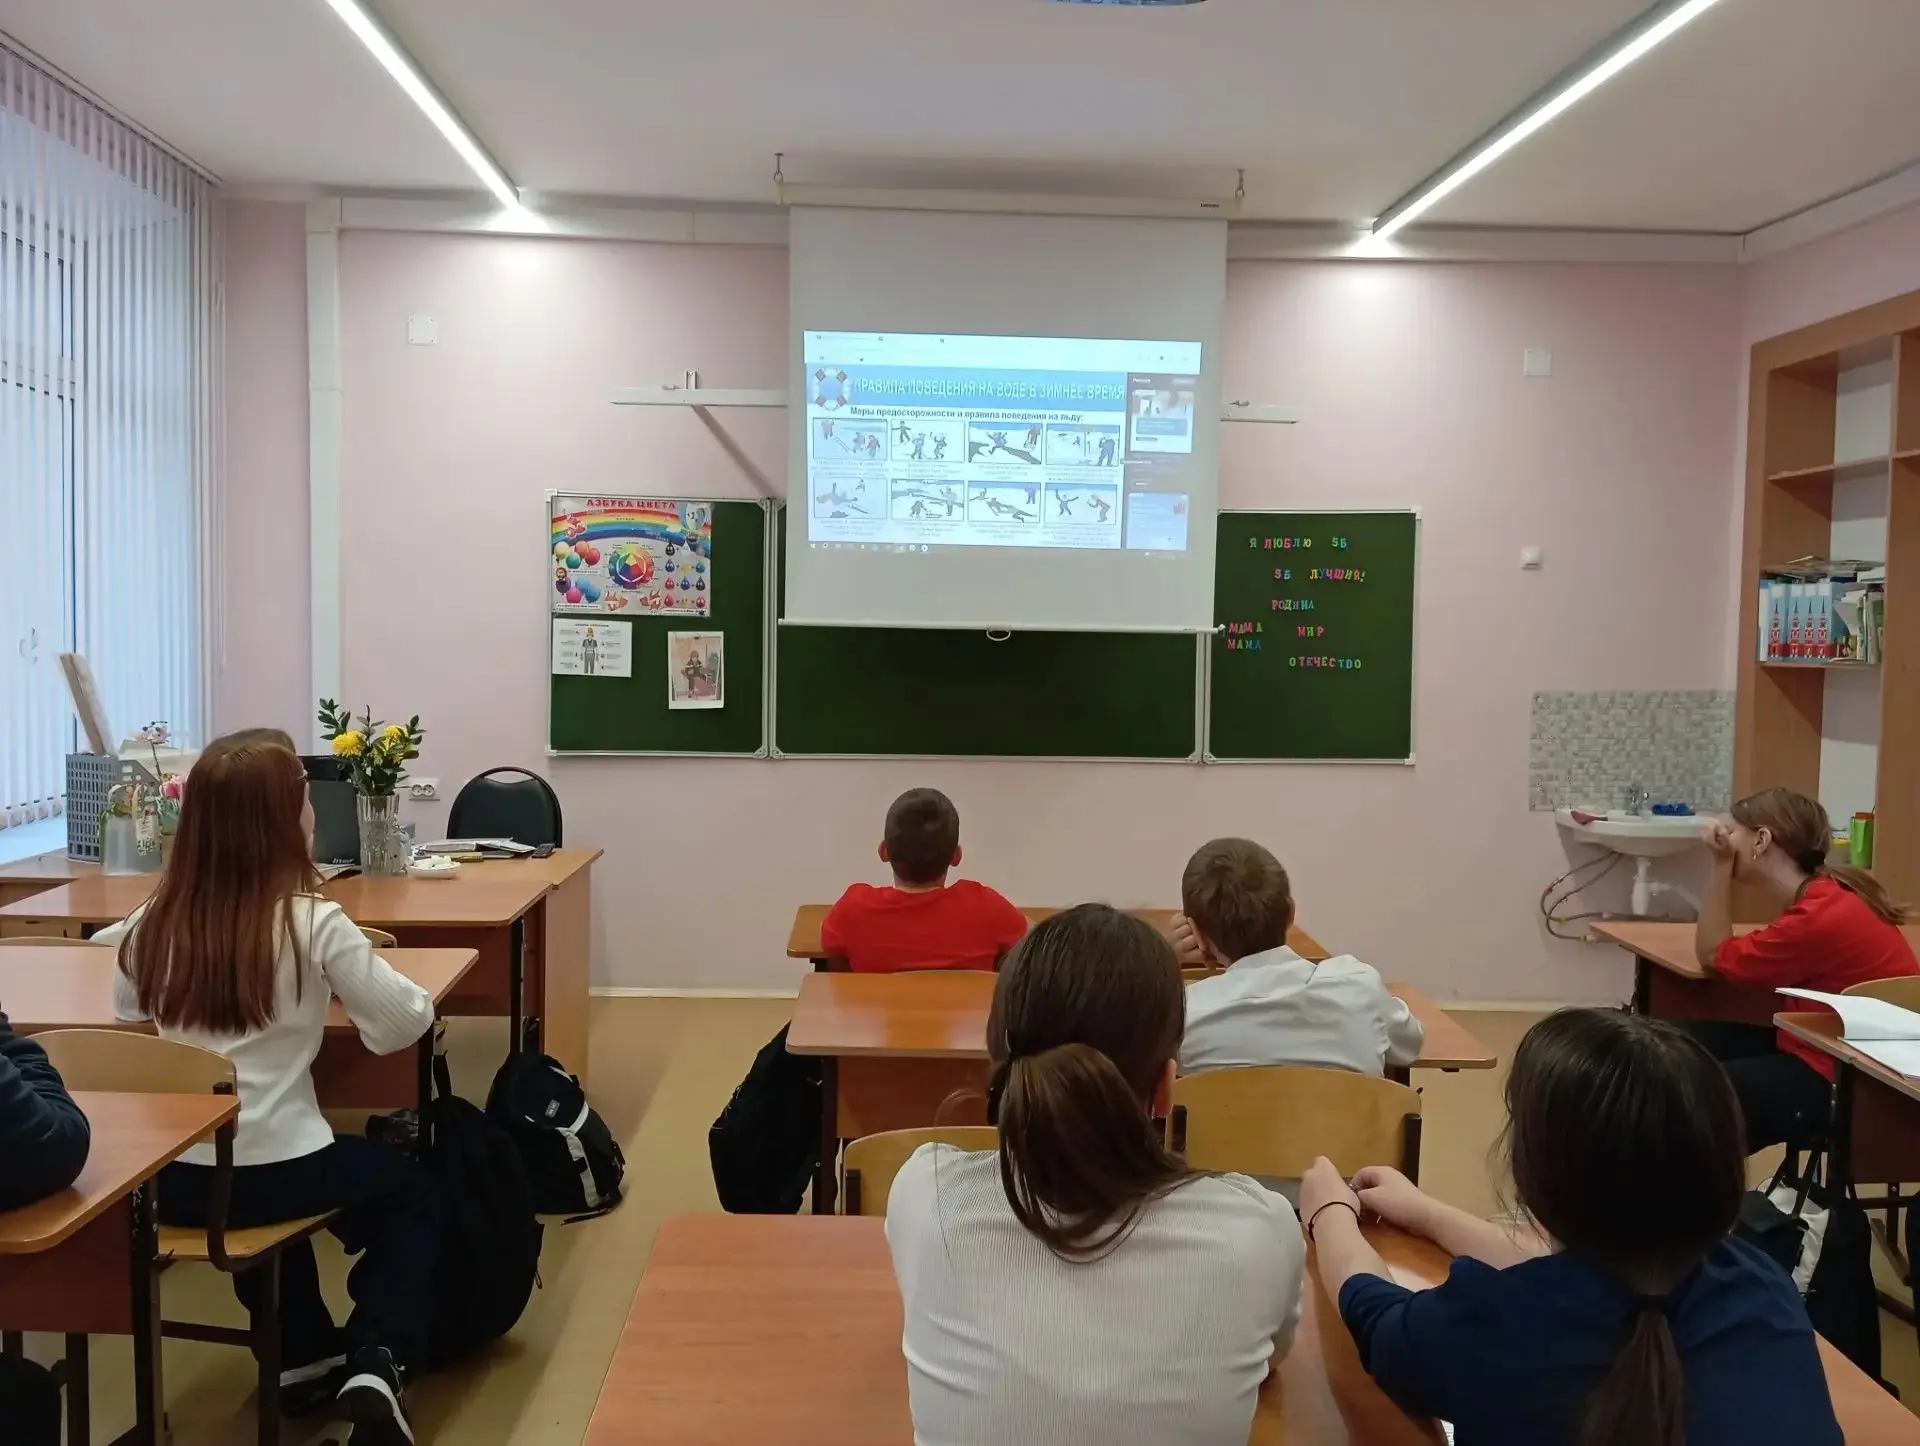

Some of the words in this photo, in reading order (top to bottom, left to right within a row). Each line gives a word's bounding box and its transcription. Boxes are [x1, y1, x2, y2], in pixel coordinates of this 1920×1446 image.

[855, 378, 905, 395] ПРАВИЛА
[908, 379, 975, 397] ПОВЕДЕНИЯ
[979, 382, 994, 397] НА
[997, 383, 1026, 400] ВОДЕ
[1029, 384, 1037, 398] В
[1041, 383, 1084, 399] ЗИМНЕЕ
[1087, 384, 1125, 400] ВРЕМЯ
[850, 406, 875, 417] Меры
[876, 408, 955, 419] предосторожности
[964, 411, 1000, 420] правила
[1001, 411, 1047, 421] поведения
[586, 499, 634, 508] АЗБУКА
[636, 501, 676, 510] ЦВЕТА
[1249, 537, 1258, 548] Я
[1264, 537, 1312, 549] ЛЮБЛЮ
[1331, 537, 1348, 549] 5Б
[1271, 599, 1315, 611] РОДИНА
[1297, 626, 1325, 637] МИР
[1227, 639, 1262, 651] МАМА
